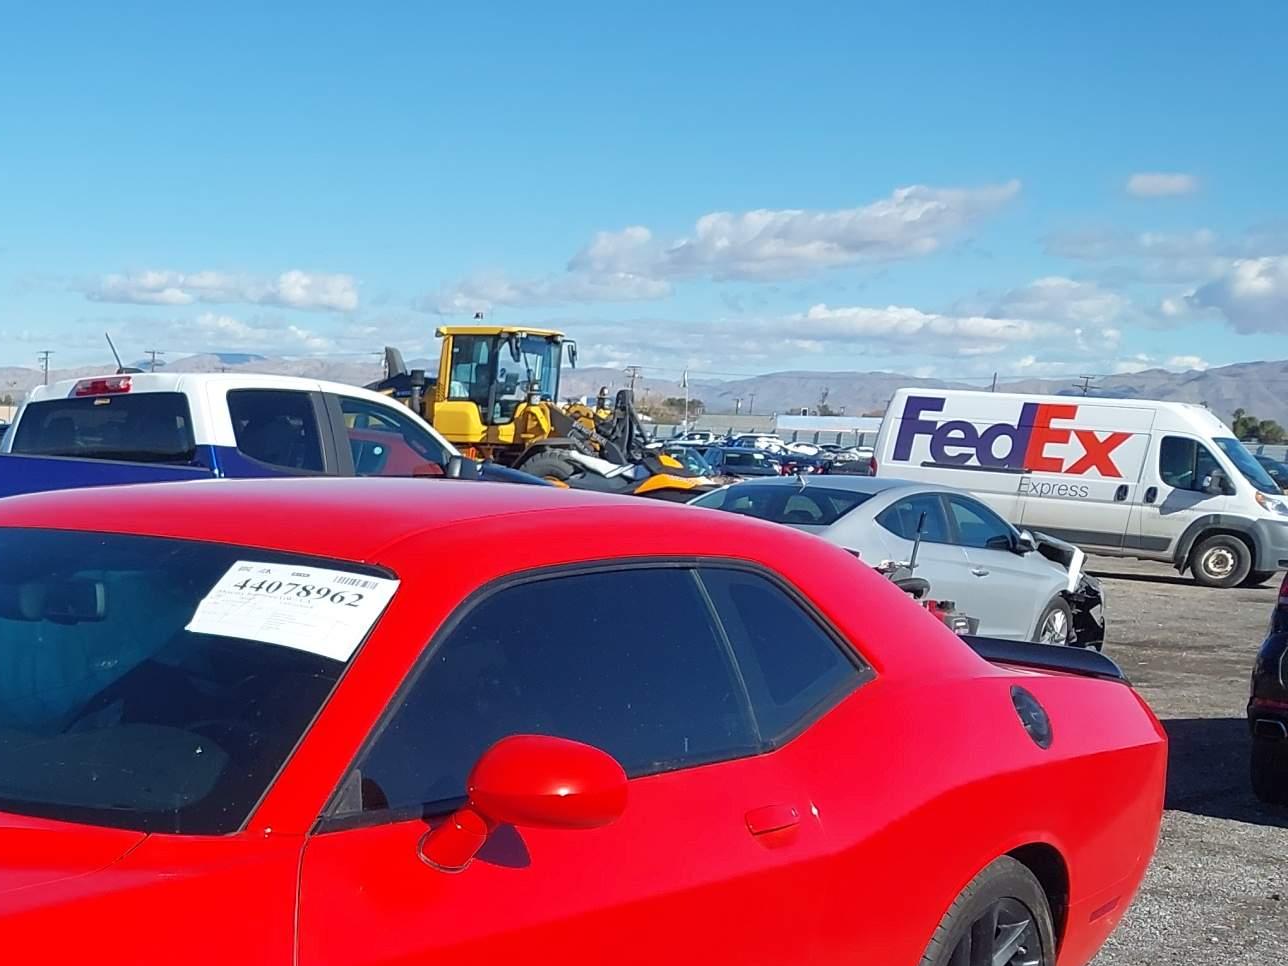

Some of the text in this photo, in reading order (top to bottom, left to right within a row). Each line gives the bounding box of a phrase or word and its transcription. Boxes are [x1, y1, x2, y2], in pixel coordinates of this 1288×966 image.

[892, 396, 1134, 479] FedEx
[1017, 478, 1089, 498] Express
[234, 578, 365, 607] 44078962
